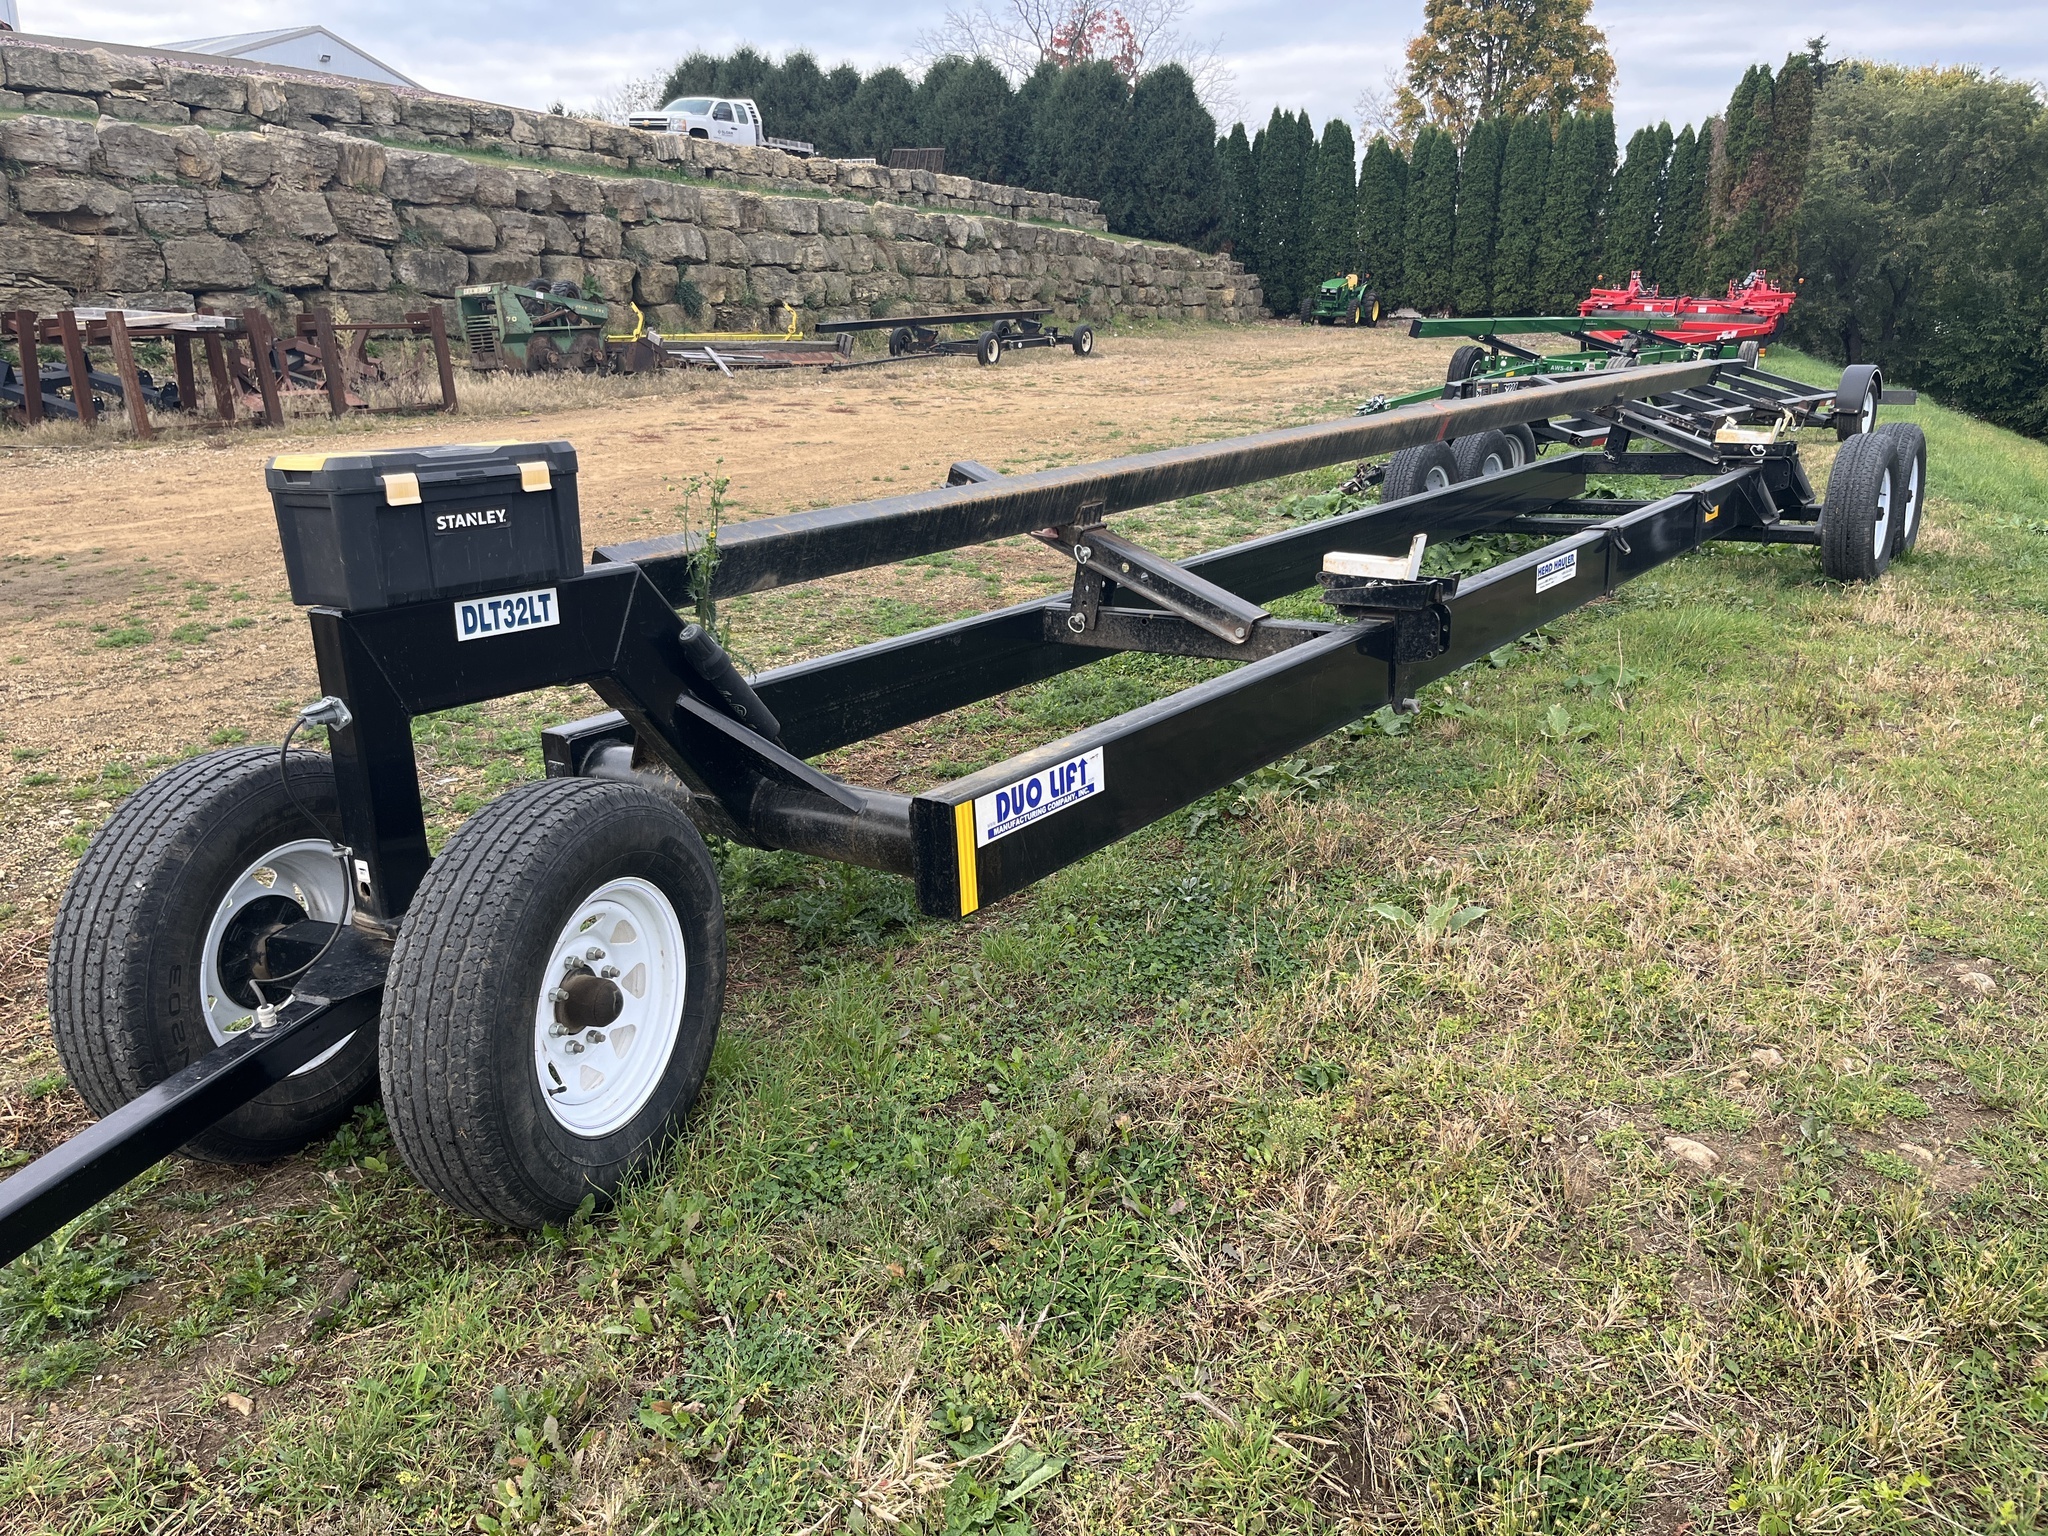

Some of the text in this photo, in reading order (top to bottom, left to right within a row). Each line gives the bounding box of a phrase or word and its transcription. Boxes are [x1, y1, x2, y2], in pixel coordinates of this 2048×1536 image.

[436, 508, 507, 531] STANLEY
[1537, 562, 1553, 577] HEAD
[1553, 553, 1575, 571] HAULER
[461, 593, 552, 635] DLT32LT
[993, 786, 1091, 836] MANUFACTURING COMPANY, INC.
[995, 777, 1042, 823] DUO
